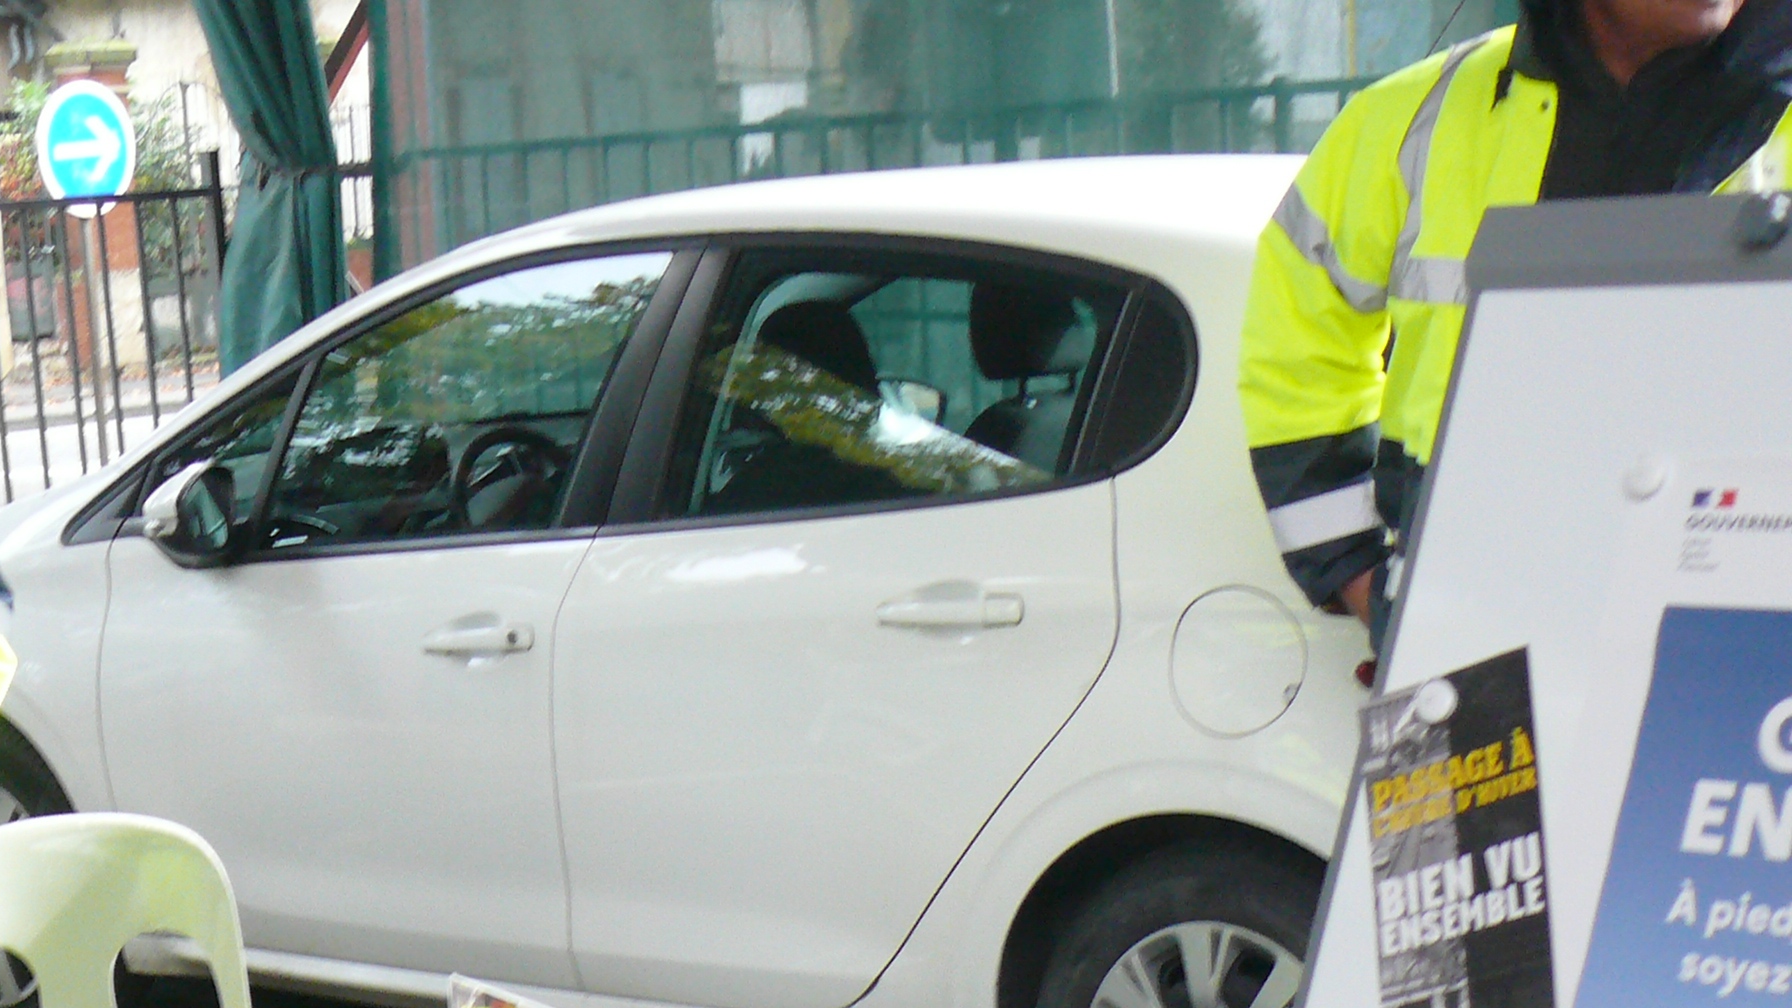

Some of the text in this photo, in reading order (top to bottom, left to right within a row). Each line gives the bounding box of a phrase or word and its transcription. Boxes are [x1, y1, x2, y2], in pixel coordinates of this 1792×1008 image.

[1509, 726, 1535, 771] À
[1377, 831, 1542, 922] BIEN VU
[1382, 875, 1546, 958] ENSEMBLE
[1664, 877, 1697, 926] À
[1676, 950, 1791, 998] soyez
